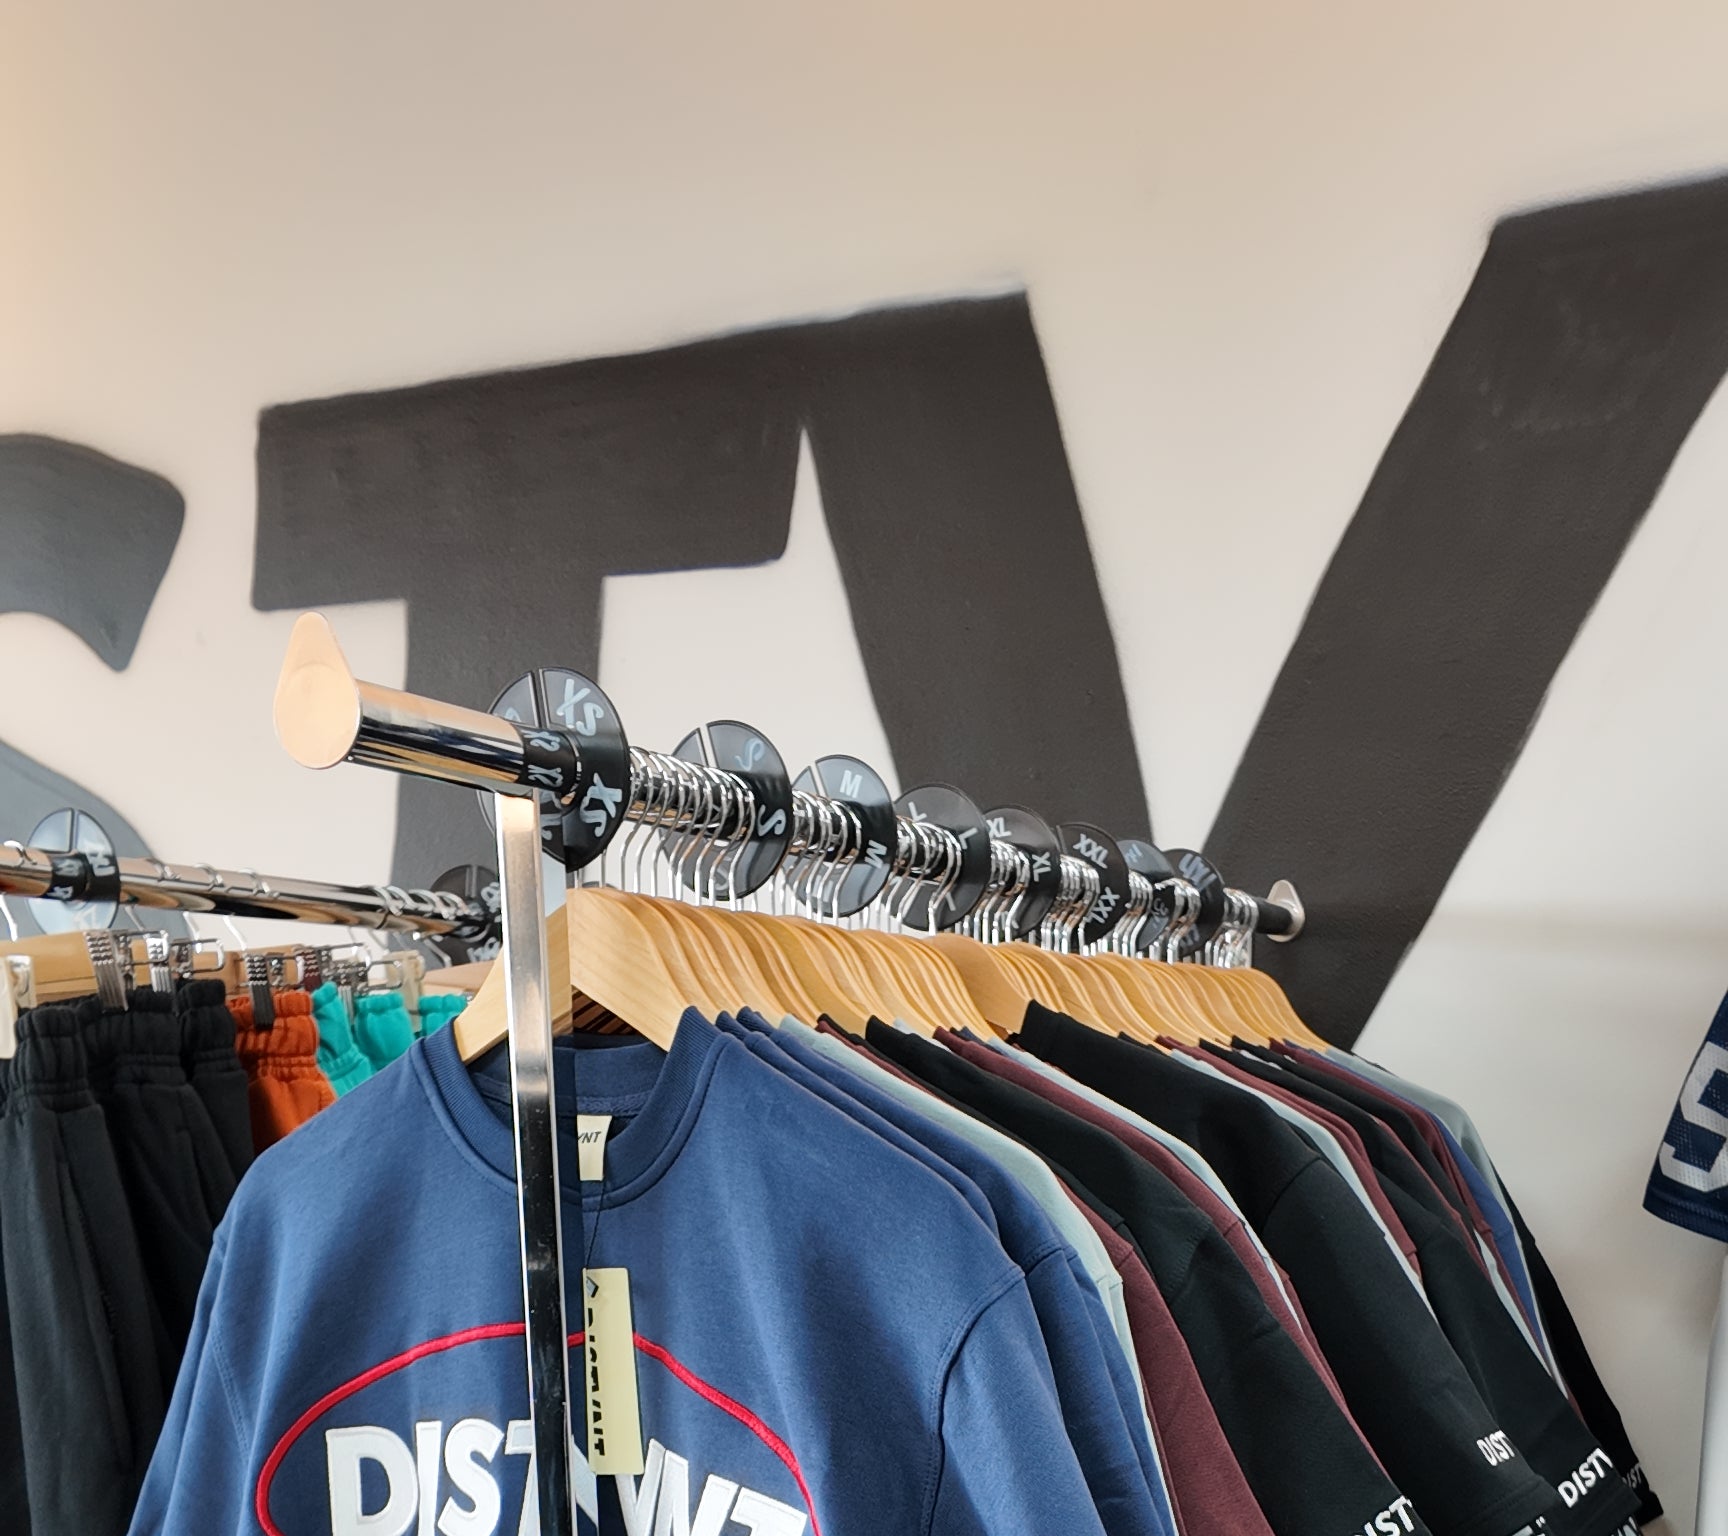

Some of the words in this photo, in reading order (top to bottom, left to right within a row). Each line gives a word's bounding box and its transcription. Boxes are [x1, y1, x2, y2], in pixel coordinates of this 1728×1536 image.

[556, 678, 604, 736] XS
[734, 738, 766, 771] S
[839, 770, 863, 799] M
[580, 772, 623, 838] XS
[757, 803, 787, 837] S
[908, 801, 928, 822] L
[957, 827, 979, 850] L
[986, 816, 1012, 840] XL
[864, 839, 888, 869] M
[1032, 852, 1052, 882] XL
[1073, 833, 1109, 870] XXL
[1085, 886, 1121, 924] XXL
